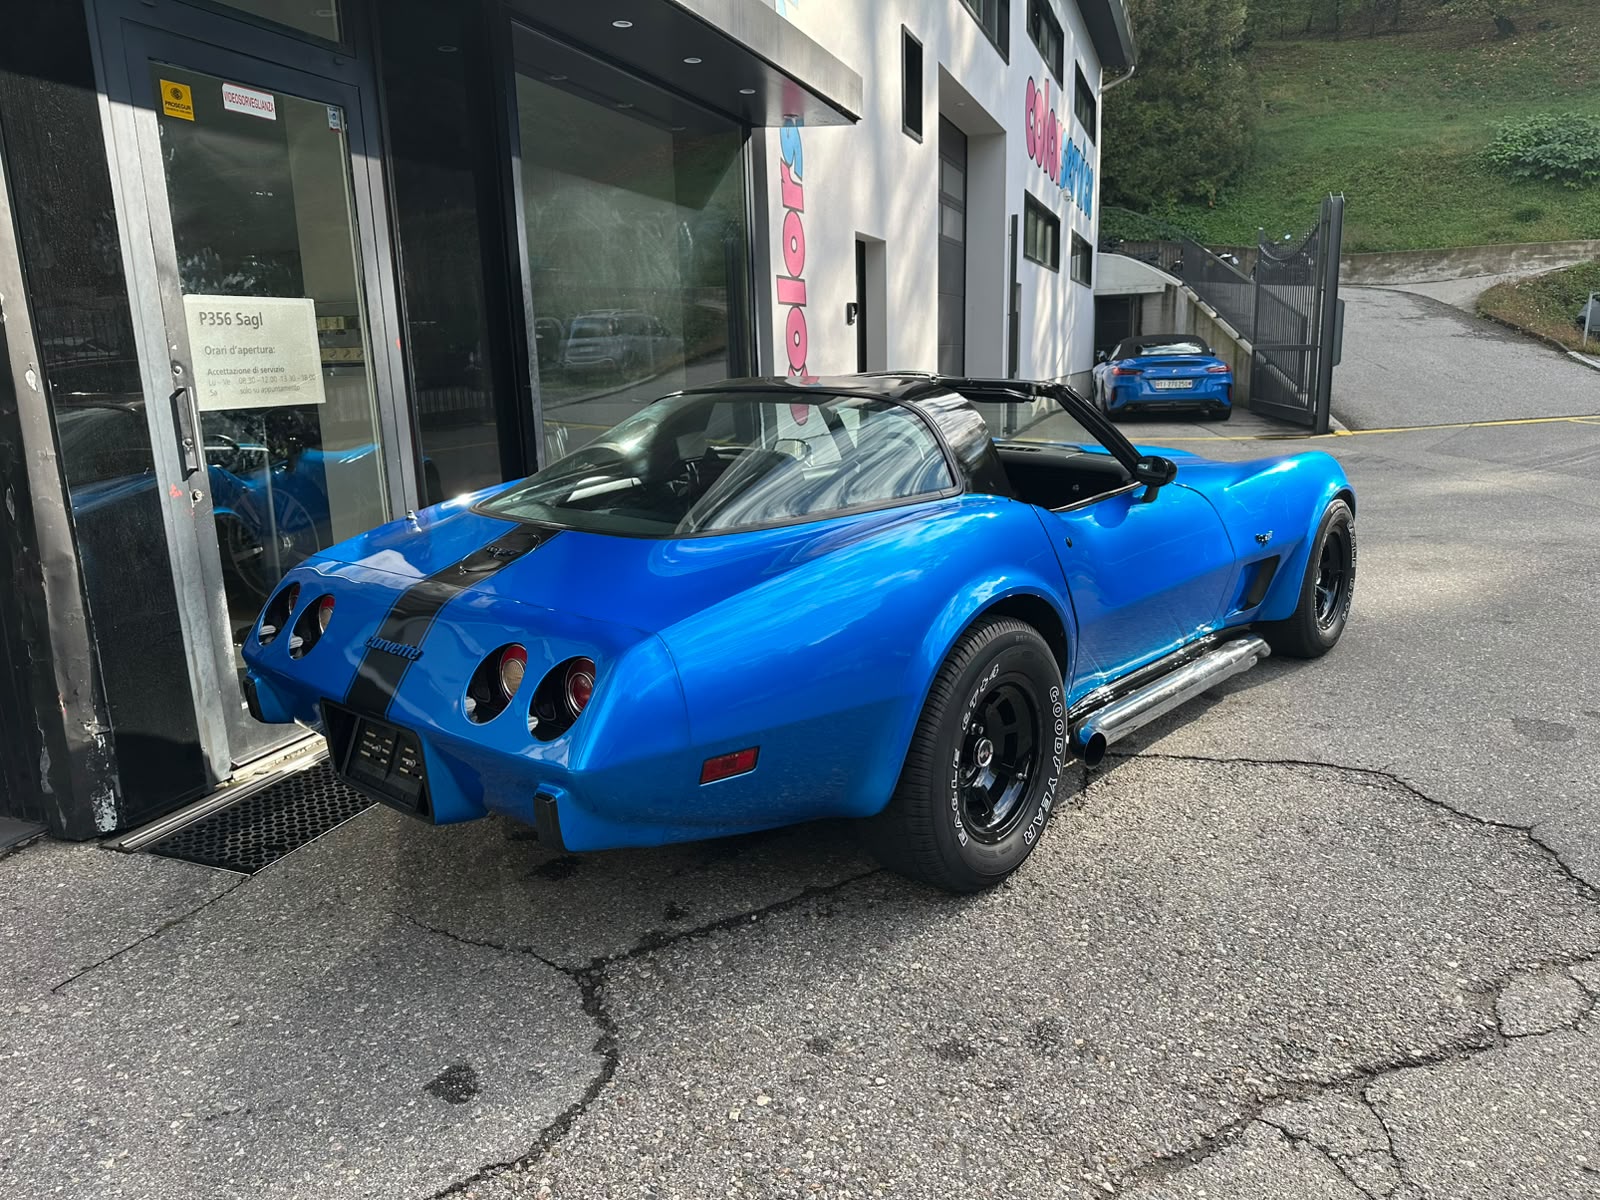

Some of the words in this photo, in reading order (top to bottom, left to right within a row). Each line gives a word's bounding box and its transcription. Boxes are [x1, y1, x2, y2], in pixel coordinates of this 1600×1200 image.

[223, 91, 275, 112] VIDEOSORVEGLIANZA
[199, 311, 232, 326] P356
[235, 311, 264, 330] Sagl
[204, 345, 227, 356] Orari
[229, 345, 276, 356] d'apertura:
[207, 367, 252, 376] Accettazione
[252, 366, 259, 374] di
[260, 366, 285, 374] servizio
[240, 386, 252, 394] solo
[1023, 685, 1064, 846] GOODYEAR
[950, 747, 969, 847] EAGLE
